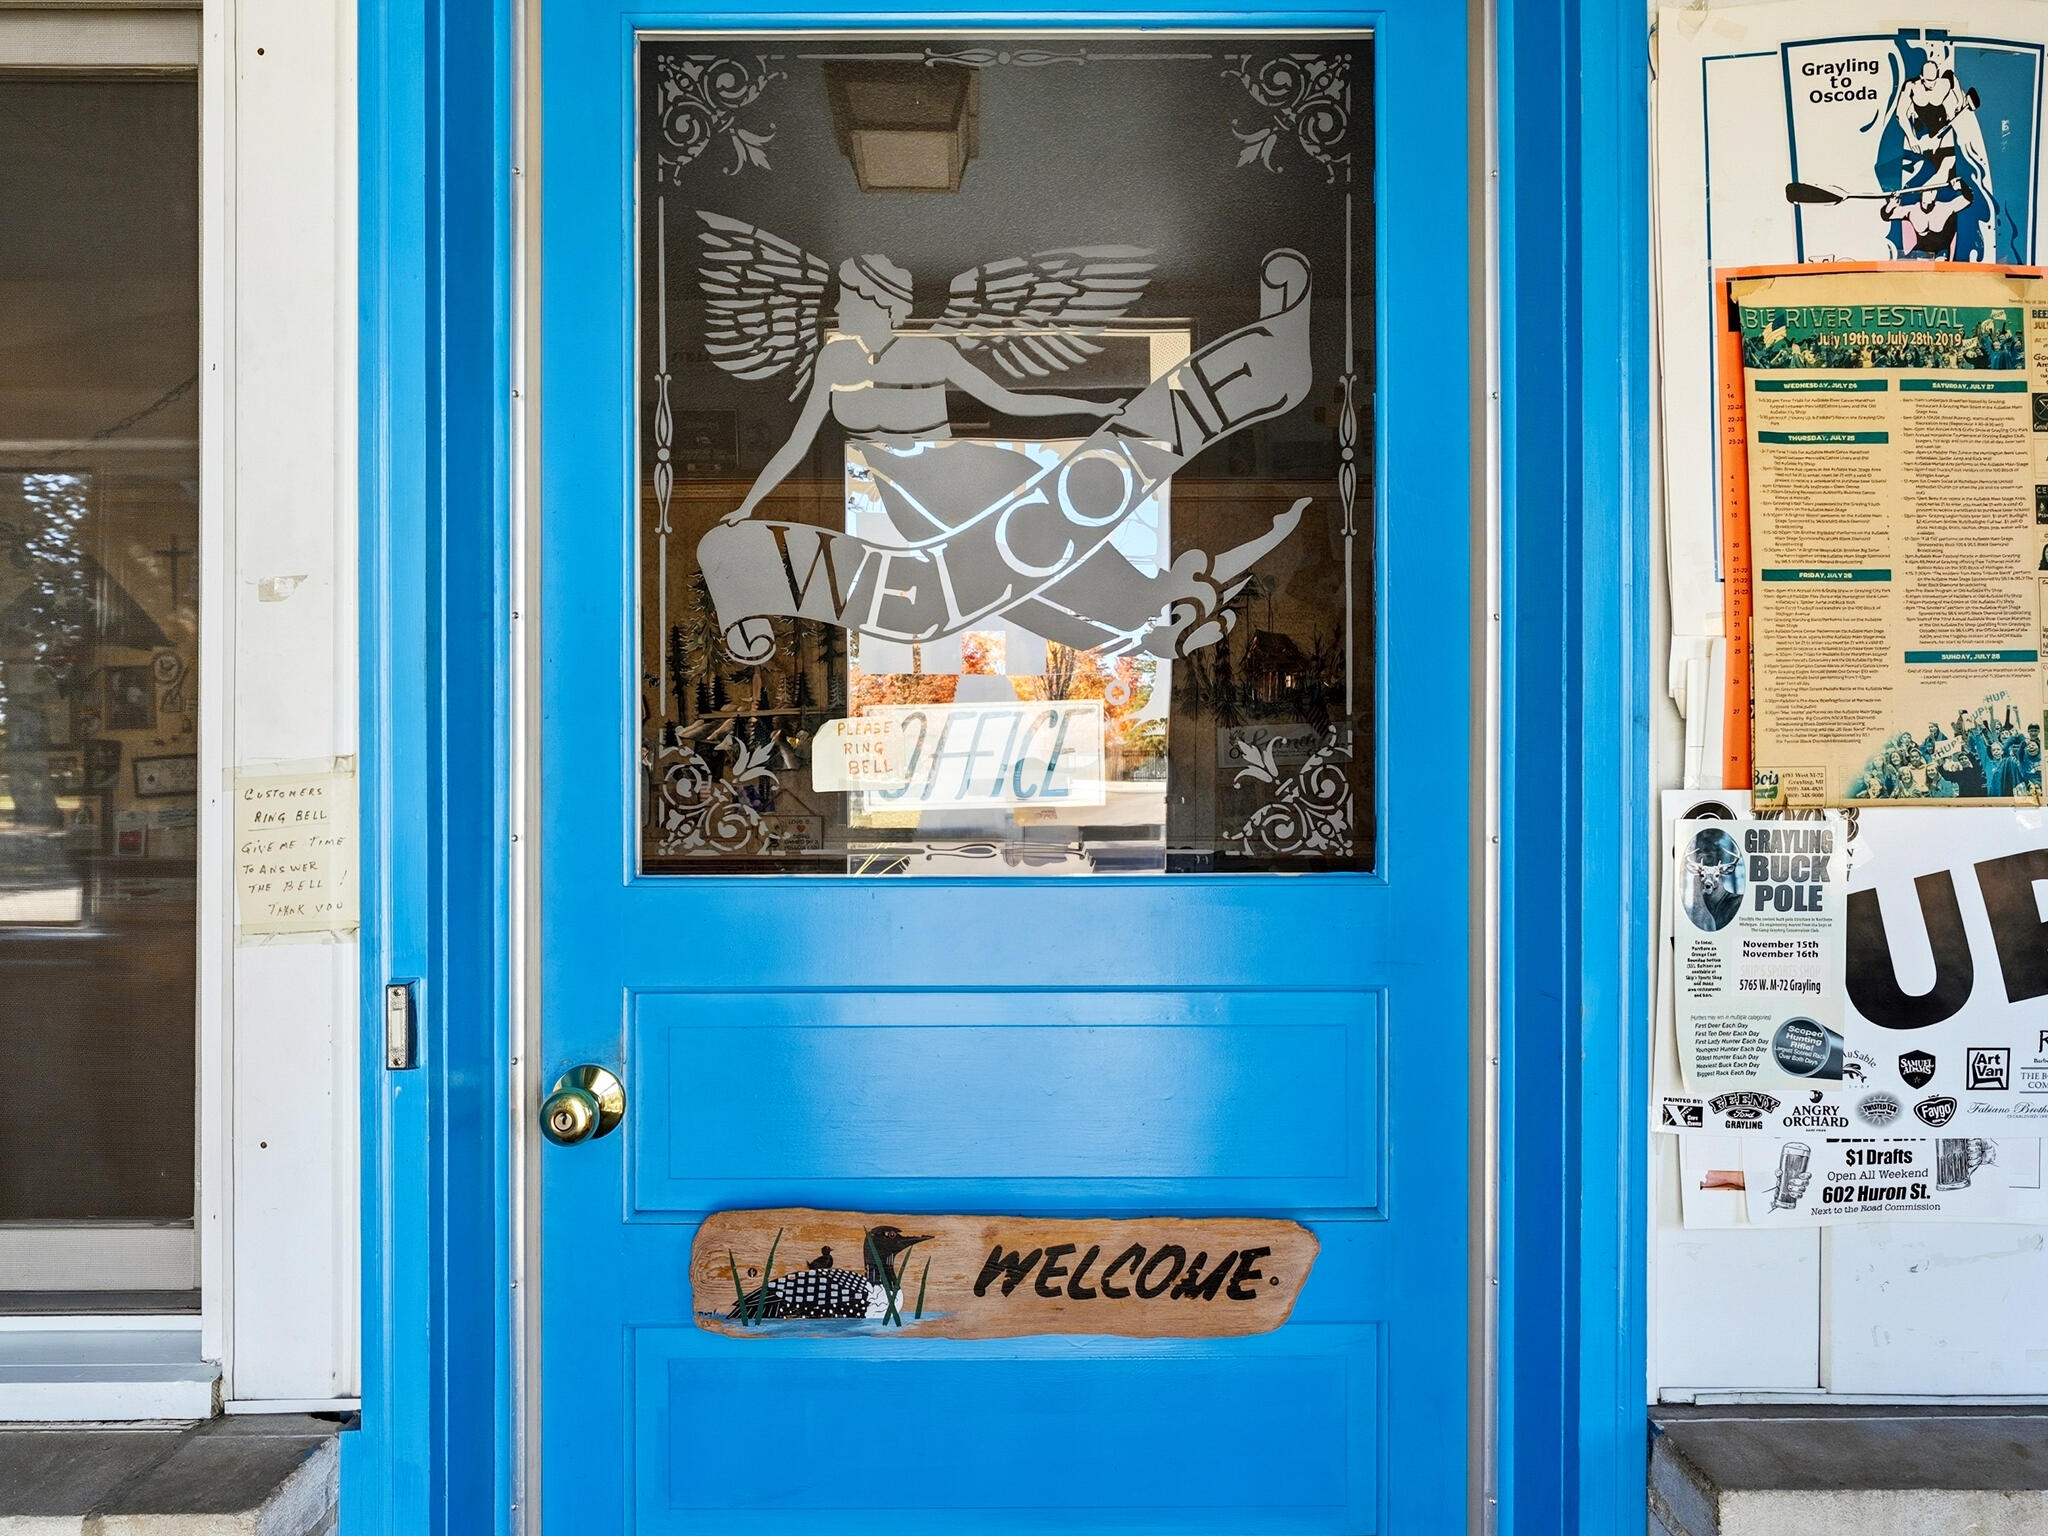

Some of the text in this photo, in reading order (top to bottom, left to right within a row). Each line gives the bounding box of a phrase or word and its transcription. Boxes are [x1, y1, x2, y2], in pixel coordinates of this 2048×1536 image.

[1801, 58, 1880, 77] Grayling
[1830, 75, 1852, 88] to
[1809, 87, 1878, 104] Oscoda
[1785, 308, 1852, 329] RIVER
[1818, 332, 1840, 348] July
[1842, 332, 1869, 346] 19th
[1871, 334, 1884, 346] to
[1886, 332, 1910, 349] July
[1911, 333, 1934, 346] 28th
[1935, 333, 1963, 347] 2019
[765, 325, 1291, 640] WELCOME
[838, 720, 893, 736] PLEASE
[844, 741, 884, 755] RING
[877, 708, 1097, 802] OFFICE
[848, 760, 893, 775] BELL
[244, 787, 323, 801] CUSTOMERS
[254, 810, 328, 824] RING BELL
[240, 836, 346, 854] GIVE ME TIME
[1744, 829, 1833, 854] GRAYLING
[258, 862, 319, 874] ANSWER
[1749, 855, 1831, 882] BUCK
[248, 883, 272, 894] THE
[282, 881, 324, 893] BELL
[1754, 884, 1823, 912] POLE
[267, 902, 343, 918] THANK YOU
[1742, 940, 1819, 949] November 15th
[1742, 950, 1819, 958] November 16th
[1739, 979, 1821, 994] 5765 W. M-72 Grayling
[1787, 1025, 1824, 1038] Scoped
[1785, 1032, 1823, 1047] Hunting
[1900, 1057, 1935, 1068] SAMUEL
[1977, 1053, 2001, 1065] Art
[1902, 1064, 1932, 1076] ADAMS
[1976, 1065, 2003, 1077] Van
[2020, 1072, 2038, 1080] THE
[1663, 1096, 1691, 1104] PRINTED
[1710, 1092, 1779, 1113] FEENY
[1732, 1108, 1757, 1119] Ford
[1792, 1104, 1841, 1117] ANGRY
[1863, 1102, 1887, 1113] TWISTED
[1921, 1102, 1951, 1120] Faygo
[1966, 1101, 2010, 1114] Fabiano
[1725, 1120, 1763, 1130] GRAYLING
[1782, 1116, 1849, 1128] ORCHARD
[1845, 1148, 1913, 1167] $1 Drafts
[1827, 1168, 1929, 1184] Open All Weekend
[1822, 1183, 1931, 1204] 602 Huron St.
[1811, 1207, 1833, 1216] Next
[1844, 1205, 1859, 1214] the
[1860, 1204, 1883, 1212] Road
[1884, 1203, 1941, 1212] Commission
[972, 1241, 1271, 1301] WELCOME
